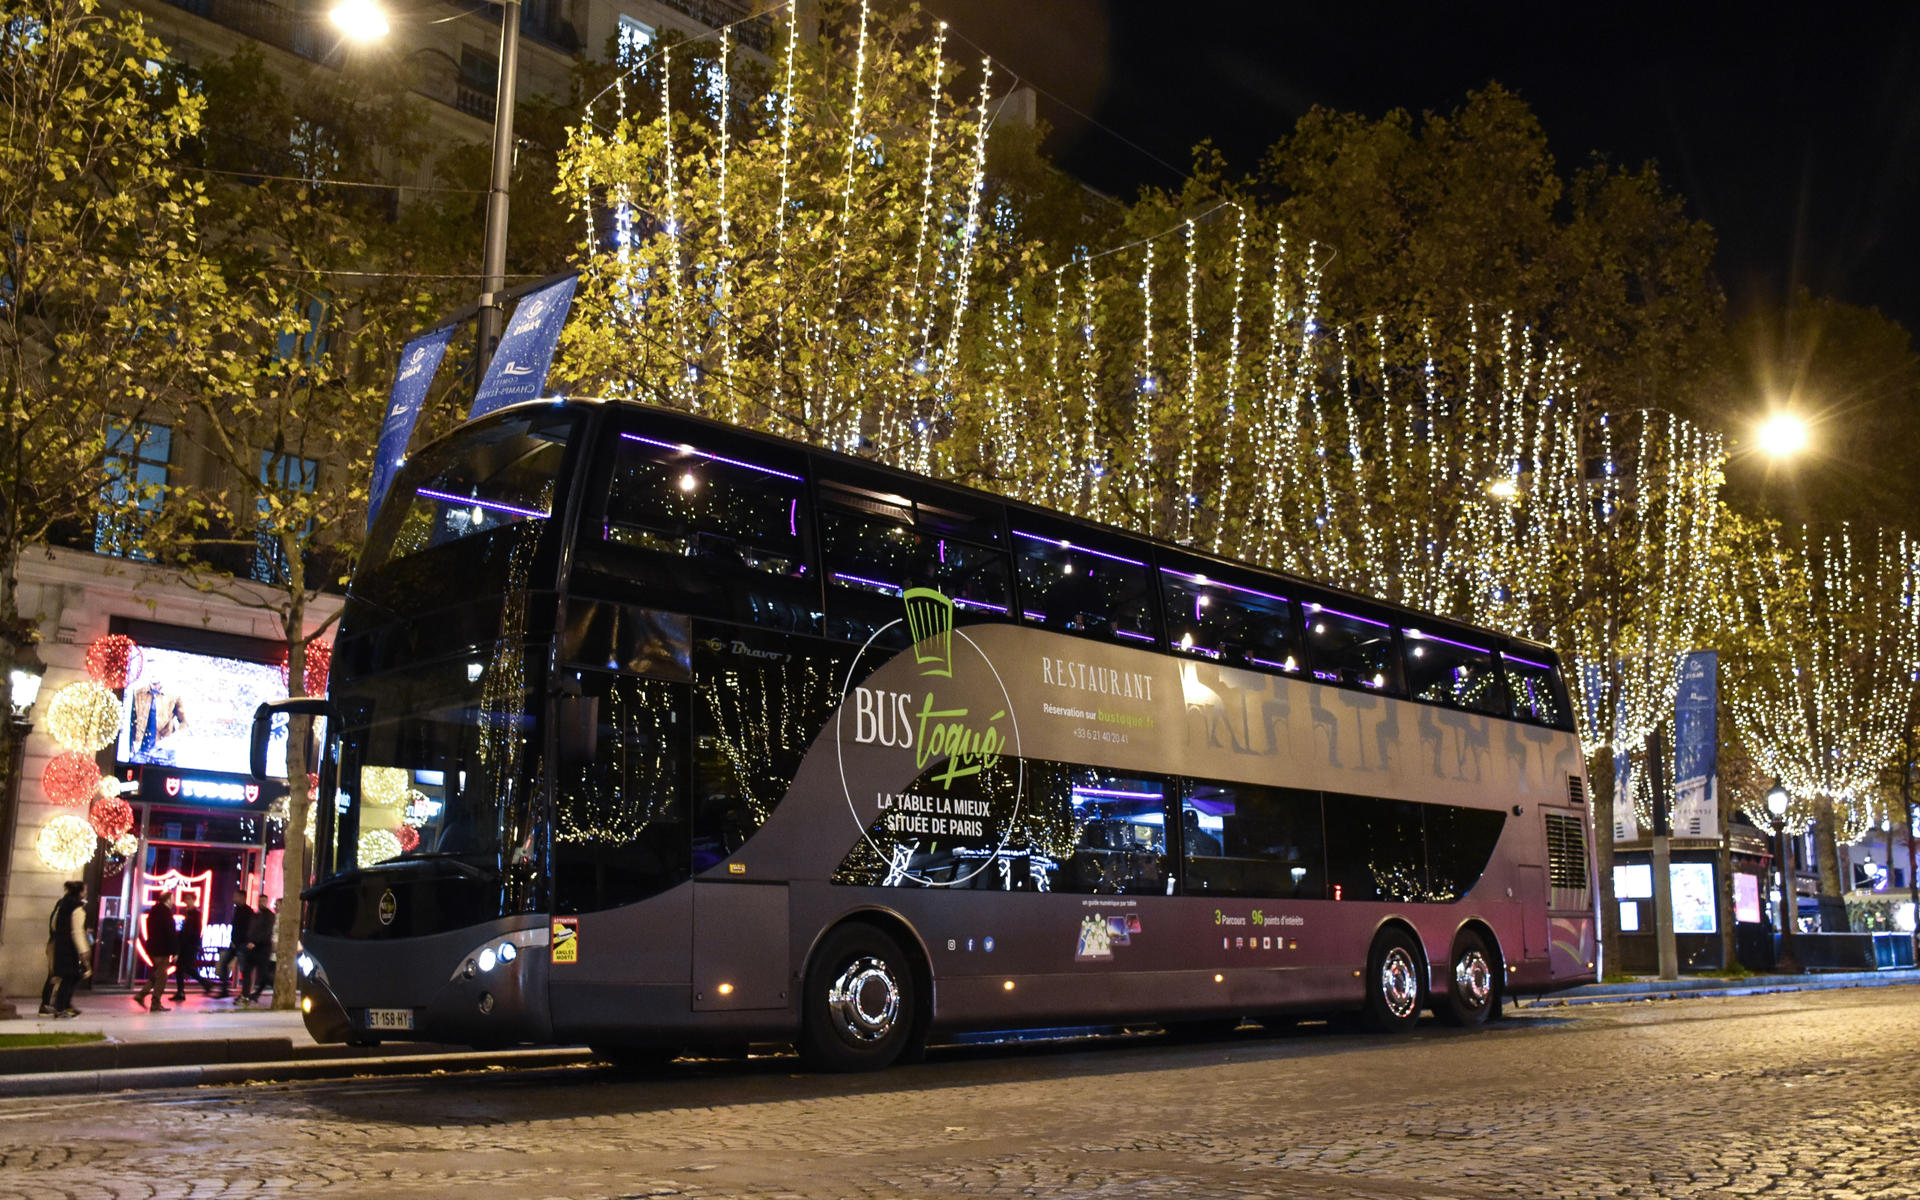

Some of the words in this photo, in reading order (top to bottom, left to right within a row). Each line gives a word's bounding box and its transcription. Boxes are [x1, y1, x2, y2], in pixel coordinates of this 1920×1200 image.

[731, 640, 783, 660] Bravo
[1042, 656, 1152, 701] RESTAURANT
[1043, 703, 1085, 719] Réservation
[1085, 710, 1097, 721] sur
[855, 687, 913, 749] BUS
[915, 692, 1006, 791] toqué
[877, 793, 893, 809] LA
[896, 794, 934, 813] TABLE
[936, 798, 951, 814] LA
[954, 800, 991, 817] MIEUX
[887, 813, 929, 834] SITUÉE
[932, 818, 947, 834] DE
[950, 819, 983, 837] PARIS
[1214, 909, 1222, 925] 3
[1221, 914, 1246, 925] Parcours
[1252, 909, 1264, 925] 96
[1264, 915, 1280, 927] points
